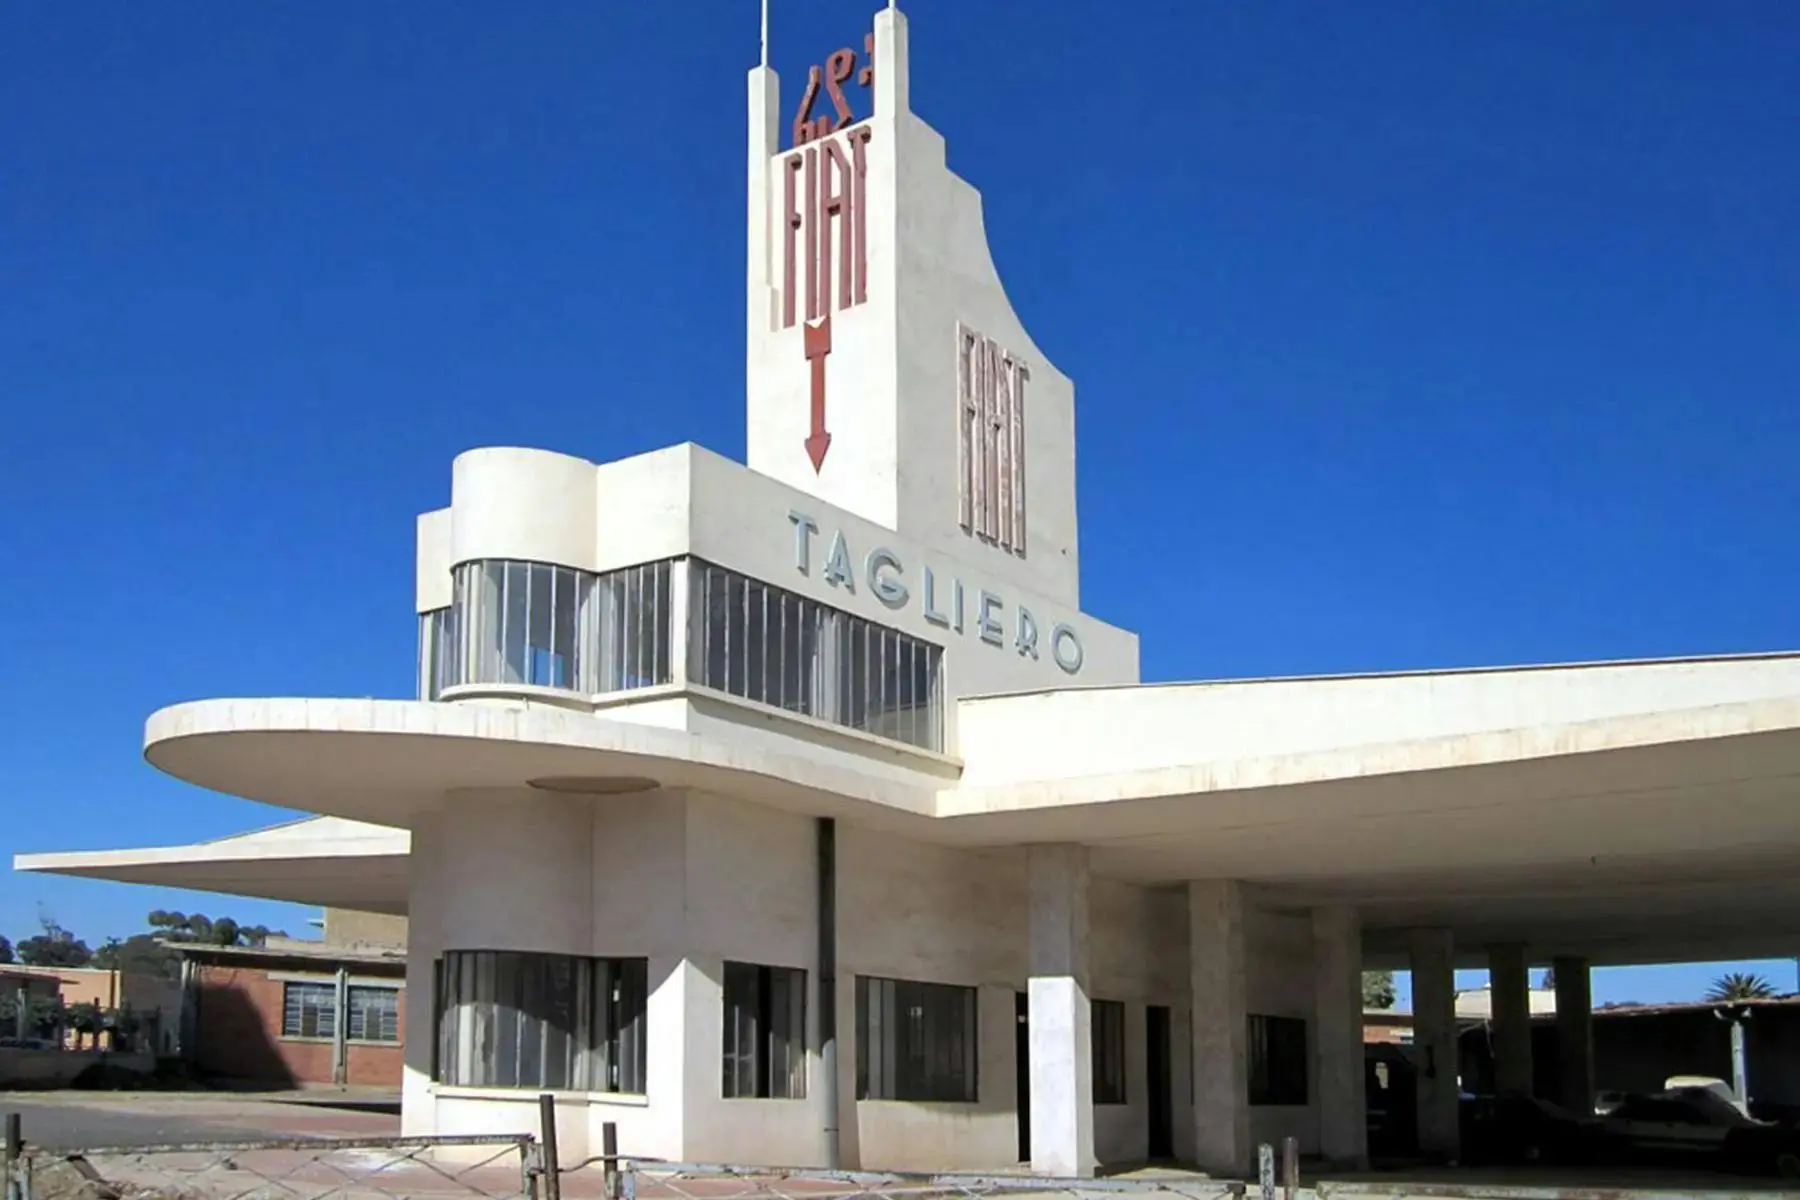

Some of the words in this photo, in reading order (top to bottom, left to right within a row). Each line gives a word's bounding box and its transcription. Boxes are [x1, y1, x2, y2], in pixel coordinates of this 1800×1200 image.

[783, 125, 871, 329] FIAT
[957, 320, 1029, 559] FIAT
[788, 509, 1083, 674] TAGLIERO
